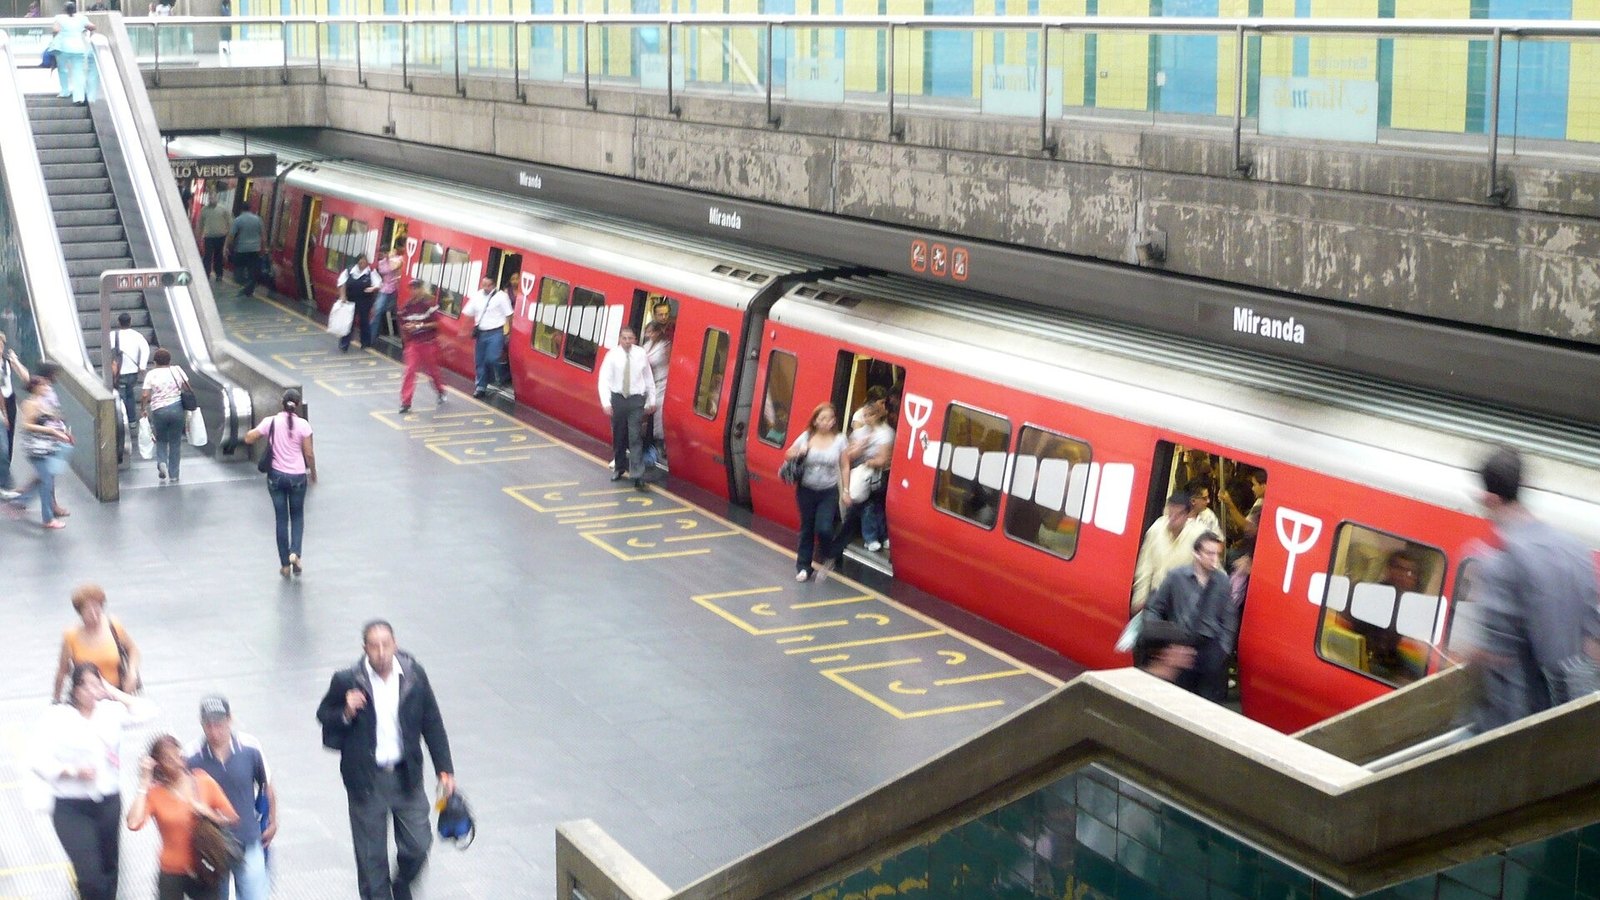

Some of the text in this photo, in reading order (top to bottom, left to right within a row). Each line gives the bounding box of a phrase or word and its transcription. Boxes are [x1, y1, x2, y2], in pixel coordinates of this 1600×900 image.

[195, 164, 235, 177] VERDE
[519, 170, 542, 189] Miranda
[709, 206, 742, 230] Miranda
[1233, 306, 1305, 344] Miranda
